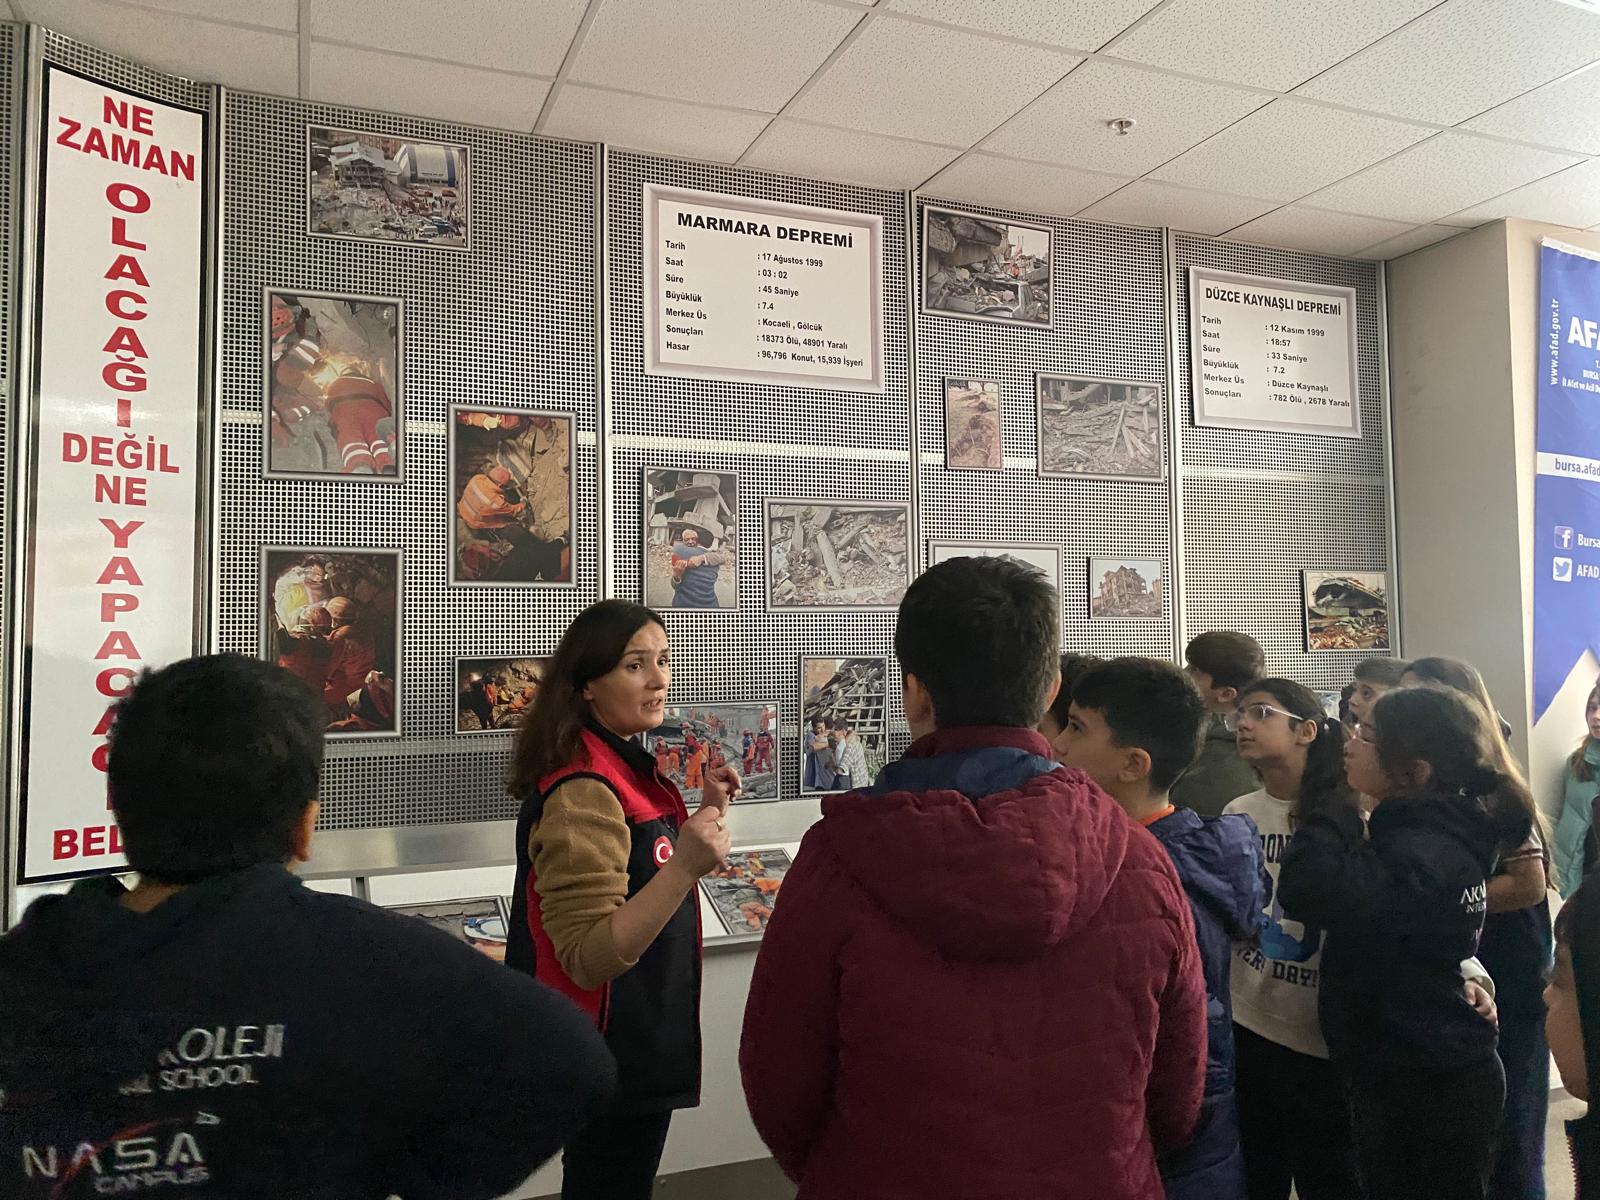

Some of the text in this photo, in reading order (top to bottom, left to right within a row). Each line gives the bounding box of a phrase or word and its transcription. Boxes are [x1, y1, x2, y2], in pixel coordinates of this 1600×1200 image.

[103, 96, 154, 136] NE
[56, 116, 195, 182] ZAMAN
[678, 212, 853, 248] MARMARA DEPREMİ
[665, 240, 686, 250] Tarih
[762, 252, 771, 261] 17
[773, 254, 804, 265] Ağustos
[805, 258, 823, 268] 1999
[665, 256, 684, 267] Saat
[665, 273, 684, 284] Süre
[762, 285, 772, 293] 45
[774, 286, 799, 298] Saniye
[665, 290, 702, 303] Büyüklük
[762, 301, 774, 310] 7.4
[1205, 286, 1341, 316] DÜZCE KAYNAŞLI DEPREMİ
[665, 307, 695, 318] Merkez
[696, 309, 707, 320] Üs
[762, 318, 791, 328] Kocaeli
[797, 321, 823, 331] Gölcük
[1201, 315, 1222, 325] Tarih
[1270, 324, 1279, 332] 12
[1281, 325, 1305, 335] Kasım
[1306, 328, 1325, 337] 1999
[666, 324, 704, 336] Sonuçları
[761, 334, 784, 343] 18373
[802, 338, 825, 347] 48901
[827, 340, 848, 350] Yaralı
[1202, 329, 1220, 339] Saat
[1270, 338, 1291, 347] 18:57
[1549, 298, 1561, 385] www.afad.gov.tr
[1568, 316, 1600, 351] AF
[666, 341, 690, 351] Hasar
[761, 350, 787, 360] 96,796
[791, 353, 816, 364] Konut,
[817, 355, 842, 365] 15,939
[843, 355, 864, 367] İşyeri
[1202, 344, 1221, 354] Süre
[1271, 352, 1281, 360] 33
[1282, 353, 1308, 363] Saniye
[1203, 358, 1239, 369] Büyüklük
[1273, 366, 1285, 374] 7.2
[1203, 373, 1232, 383] Merkez
[1234, 374, 1245, 384] Üs
[1272, 380, 1295, 389] Düzce
[1296, 382, 1329, 393] Kaynaşlı
[1204, 387, 1242, 398] Sonuçları
[1273, 394, 1288, 402] 782
[1308, 397, 1327, 405] 2678
[1328, 398, 1350, 407] Yaralı
[62, 432, 180, 474] DEĞİL
[95, 474, 147, 507] NE
[21, 1132, 204, 1180] NASA
